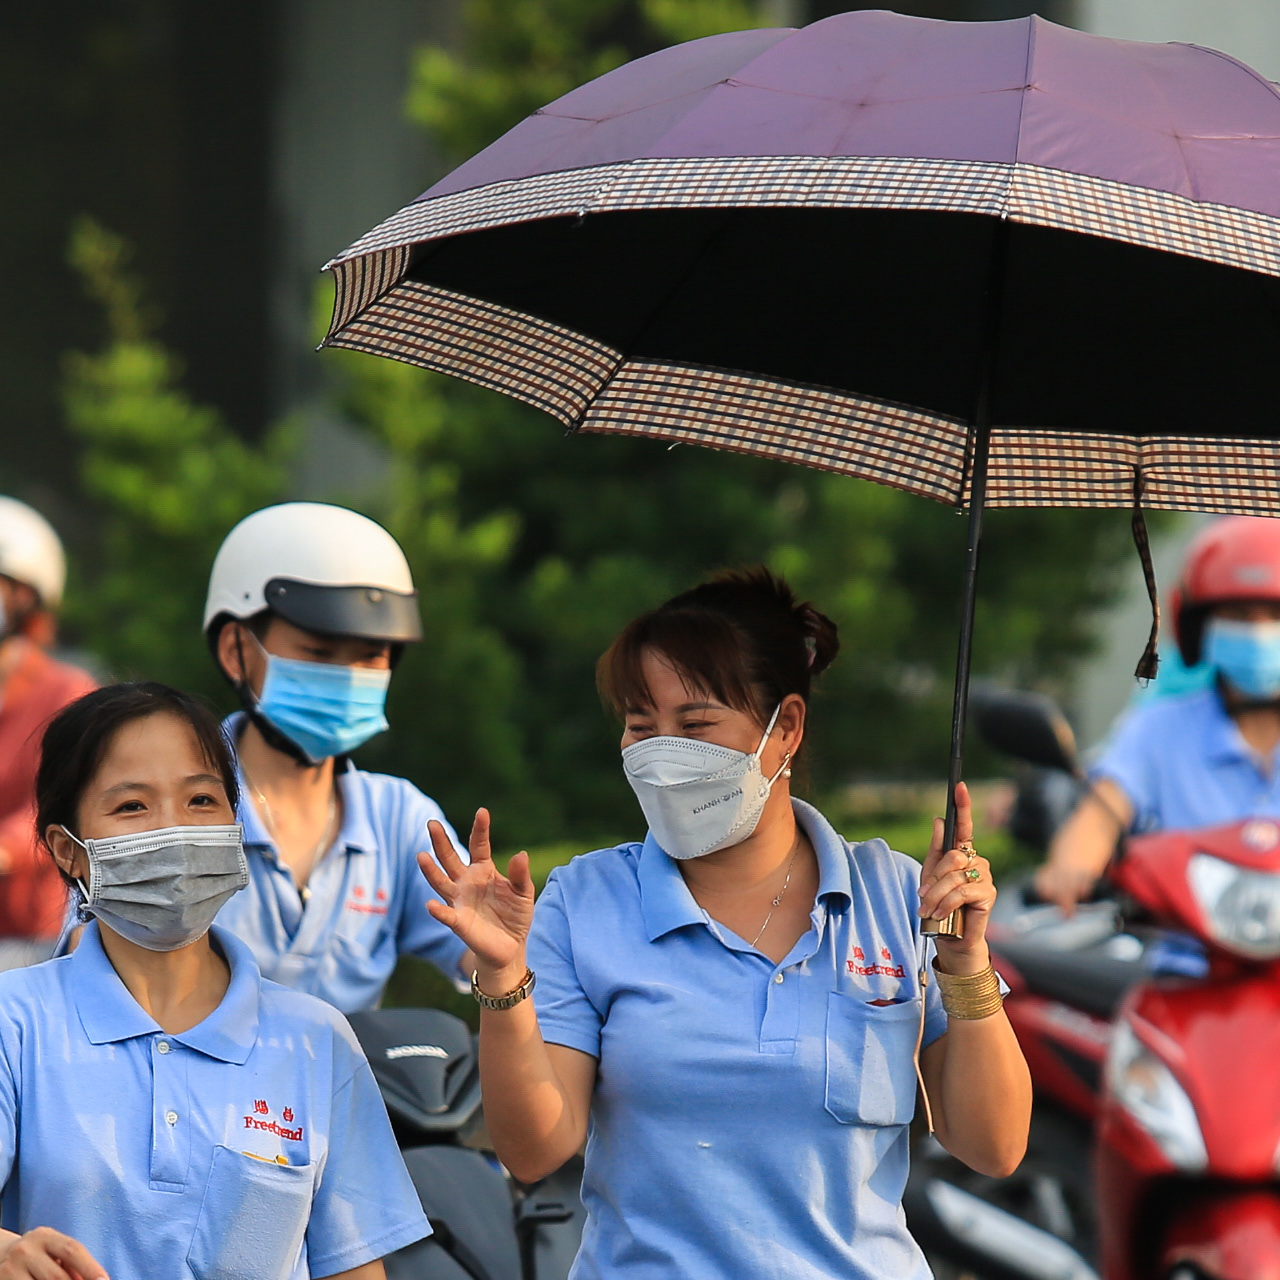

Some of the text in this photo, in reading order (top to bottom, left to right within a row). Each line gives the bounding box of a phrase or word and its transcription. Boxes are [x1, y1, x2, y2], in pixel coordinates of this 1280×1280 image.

[693, 787, 743, 814] KHANH AN
[846, 960, 906, 978] Freetrend
[243, 1116, 303, 1141] Freetrend
